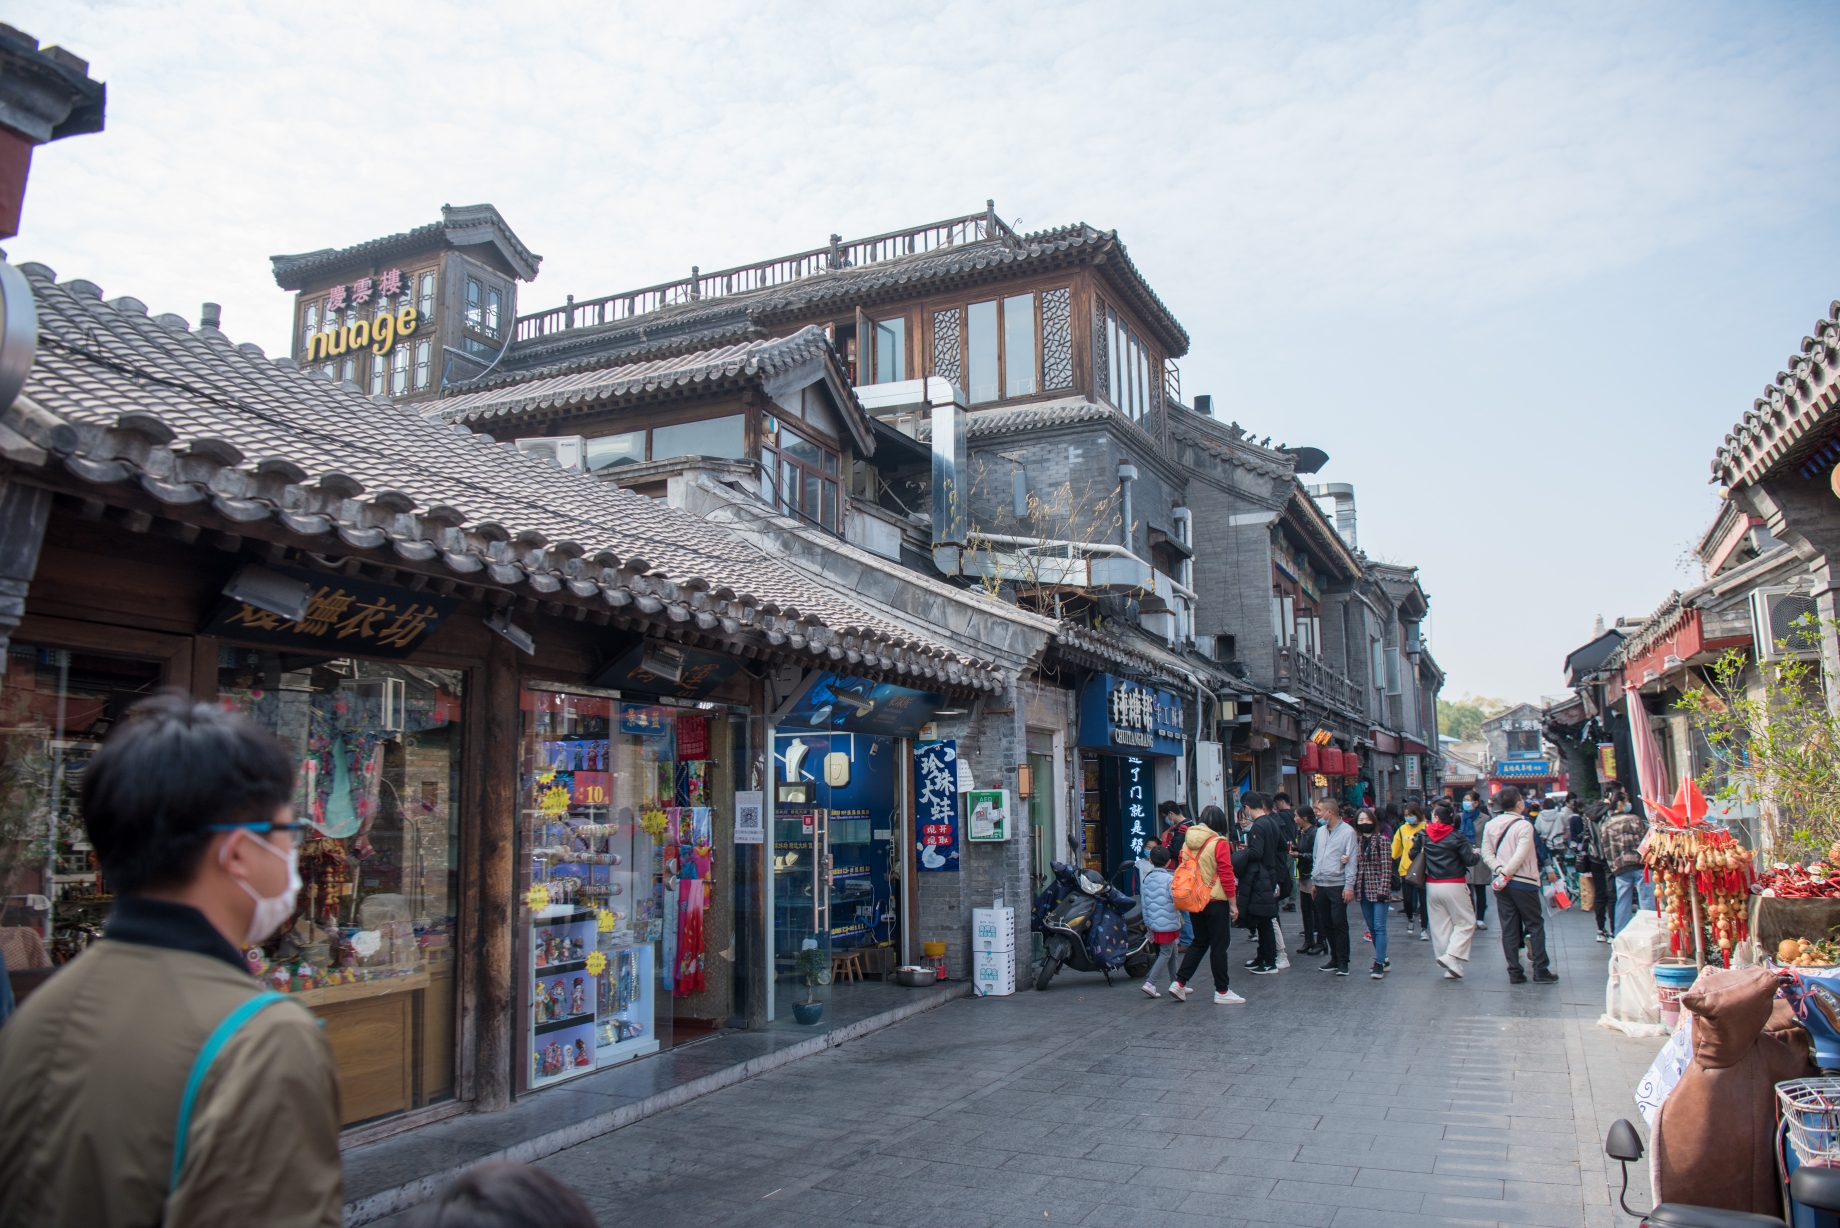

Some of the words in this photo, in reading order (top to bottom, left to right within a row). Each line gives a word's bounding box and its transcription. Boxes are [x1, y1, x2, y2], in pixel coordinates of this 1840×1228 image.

[327, 268, 404, 312] 慶雲樓
[307, 306, 418, 362] nuage
[586, 785, 604, 803] 10
[918, 752, 956, 825] 珍珠大蚌
